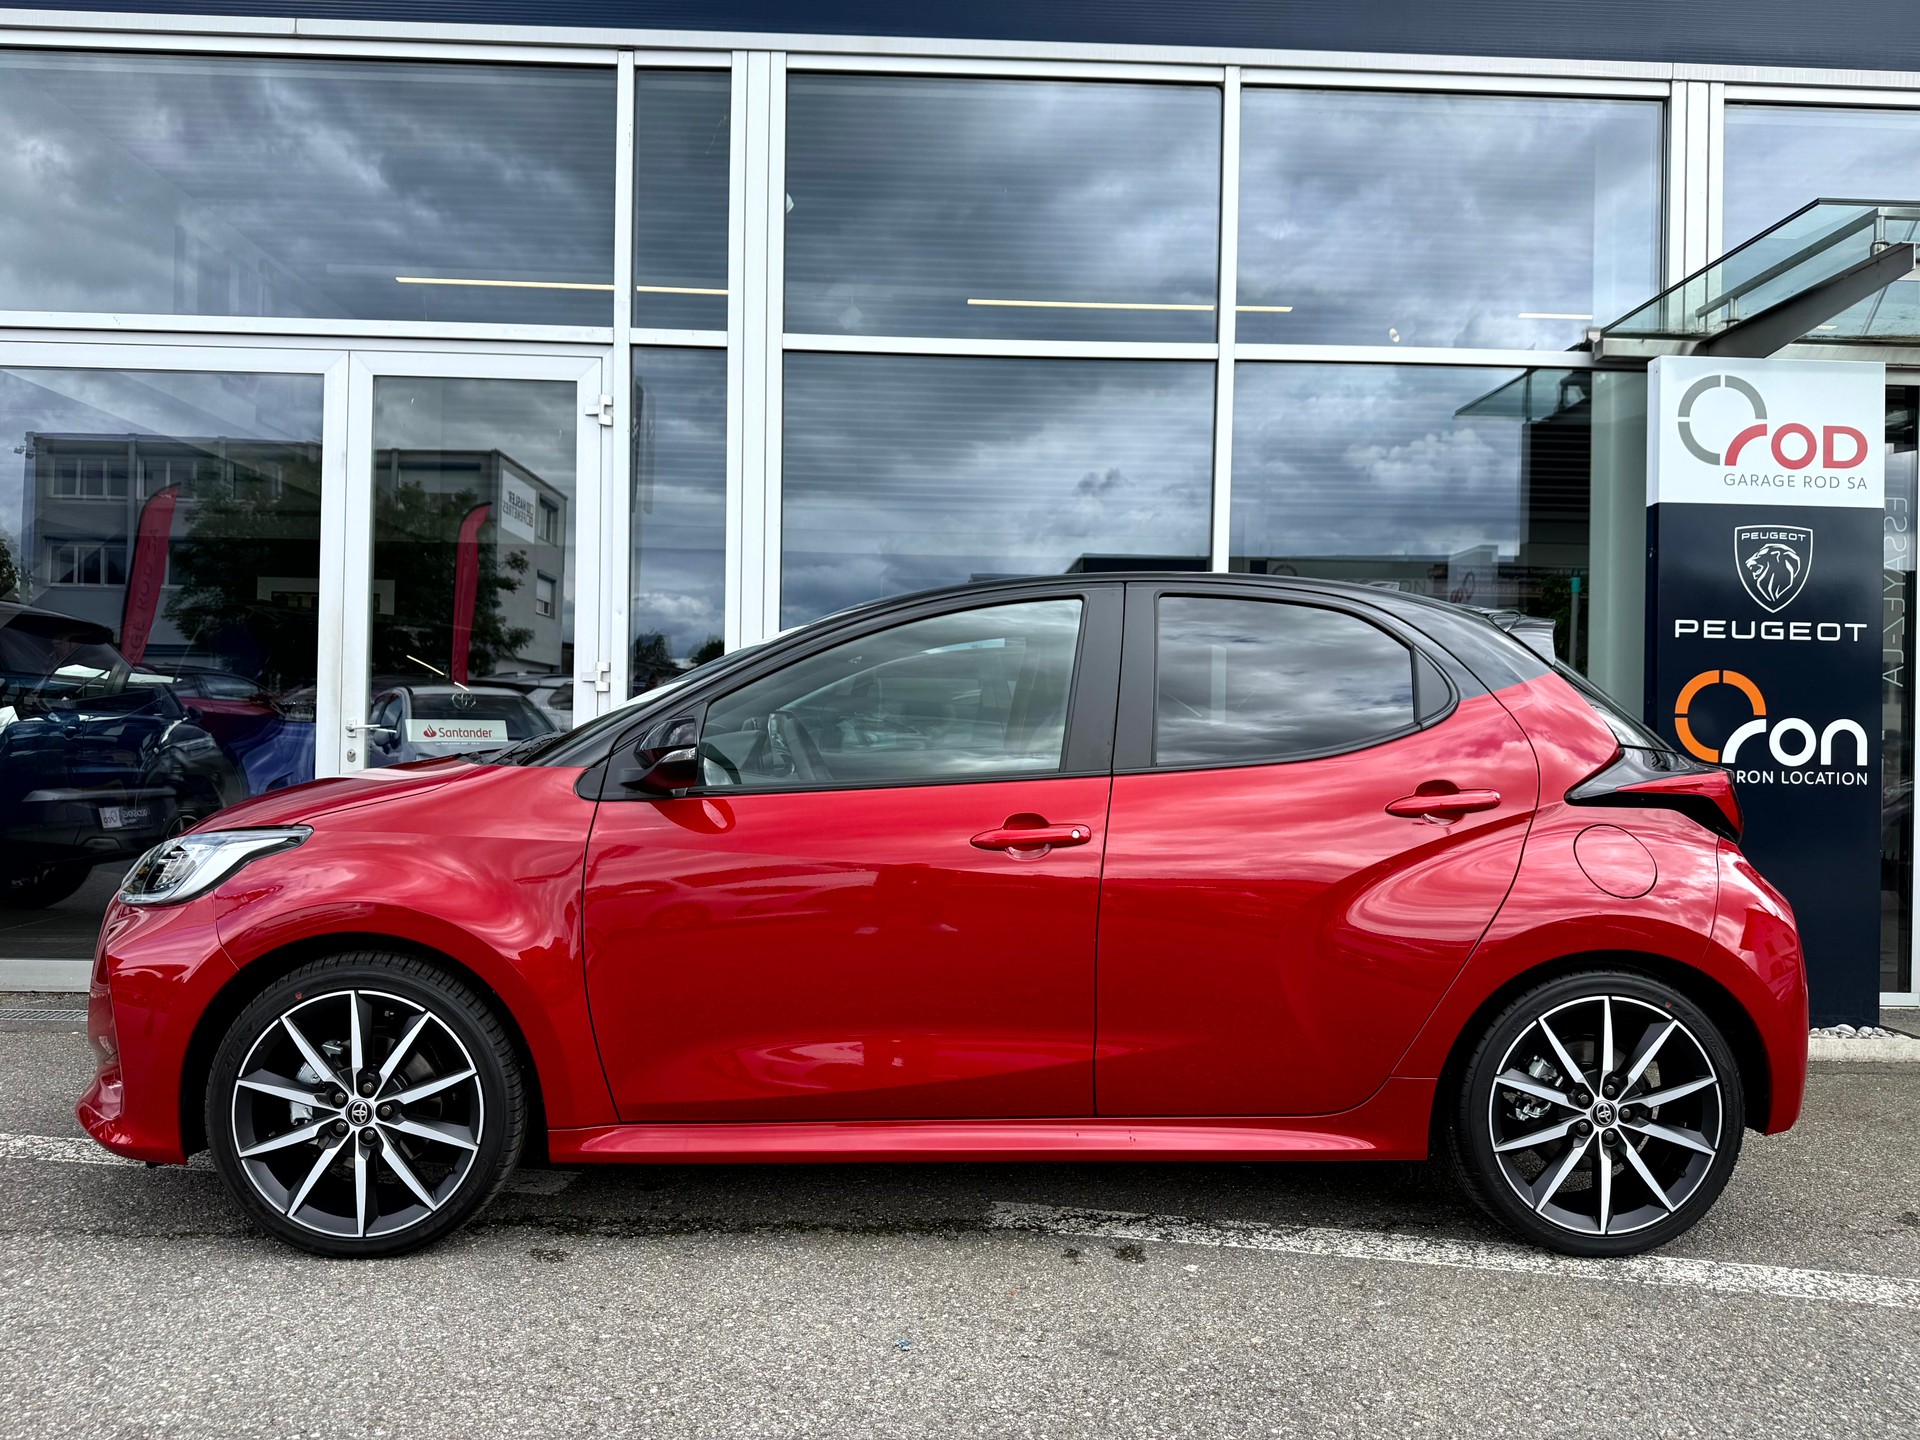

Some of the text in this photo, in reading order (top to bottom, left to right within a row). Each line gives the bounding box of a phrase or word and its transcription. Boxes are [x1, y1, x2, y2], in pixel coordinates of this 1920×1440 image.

[1724, 473, 1868, 490] GARAGE ROD SA
[1741, 531, 1807, 542] PEUGEOT
[1674, 619, 1868, 642] PEUGEOT
[439, 727, 493, 739] Santander
[1731, 769, 1868, 786] RON LOCATION
